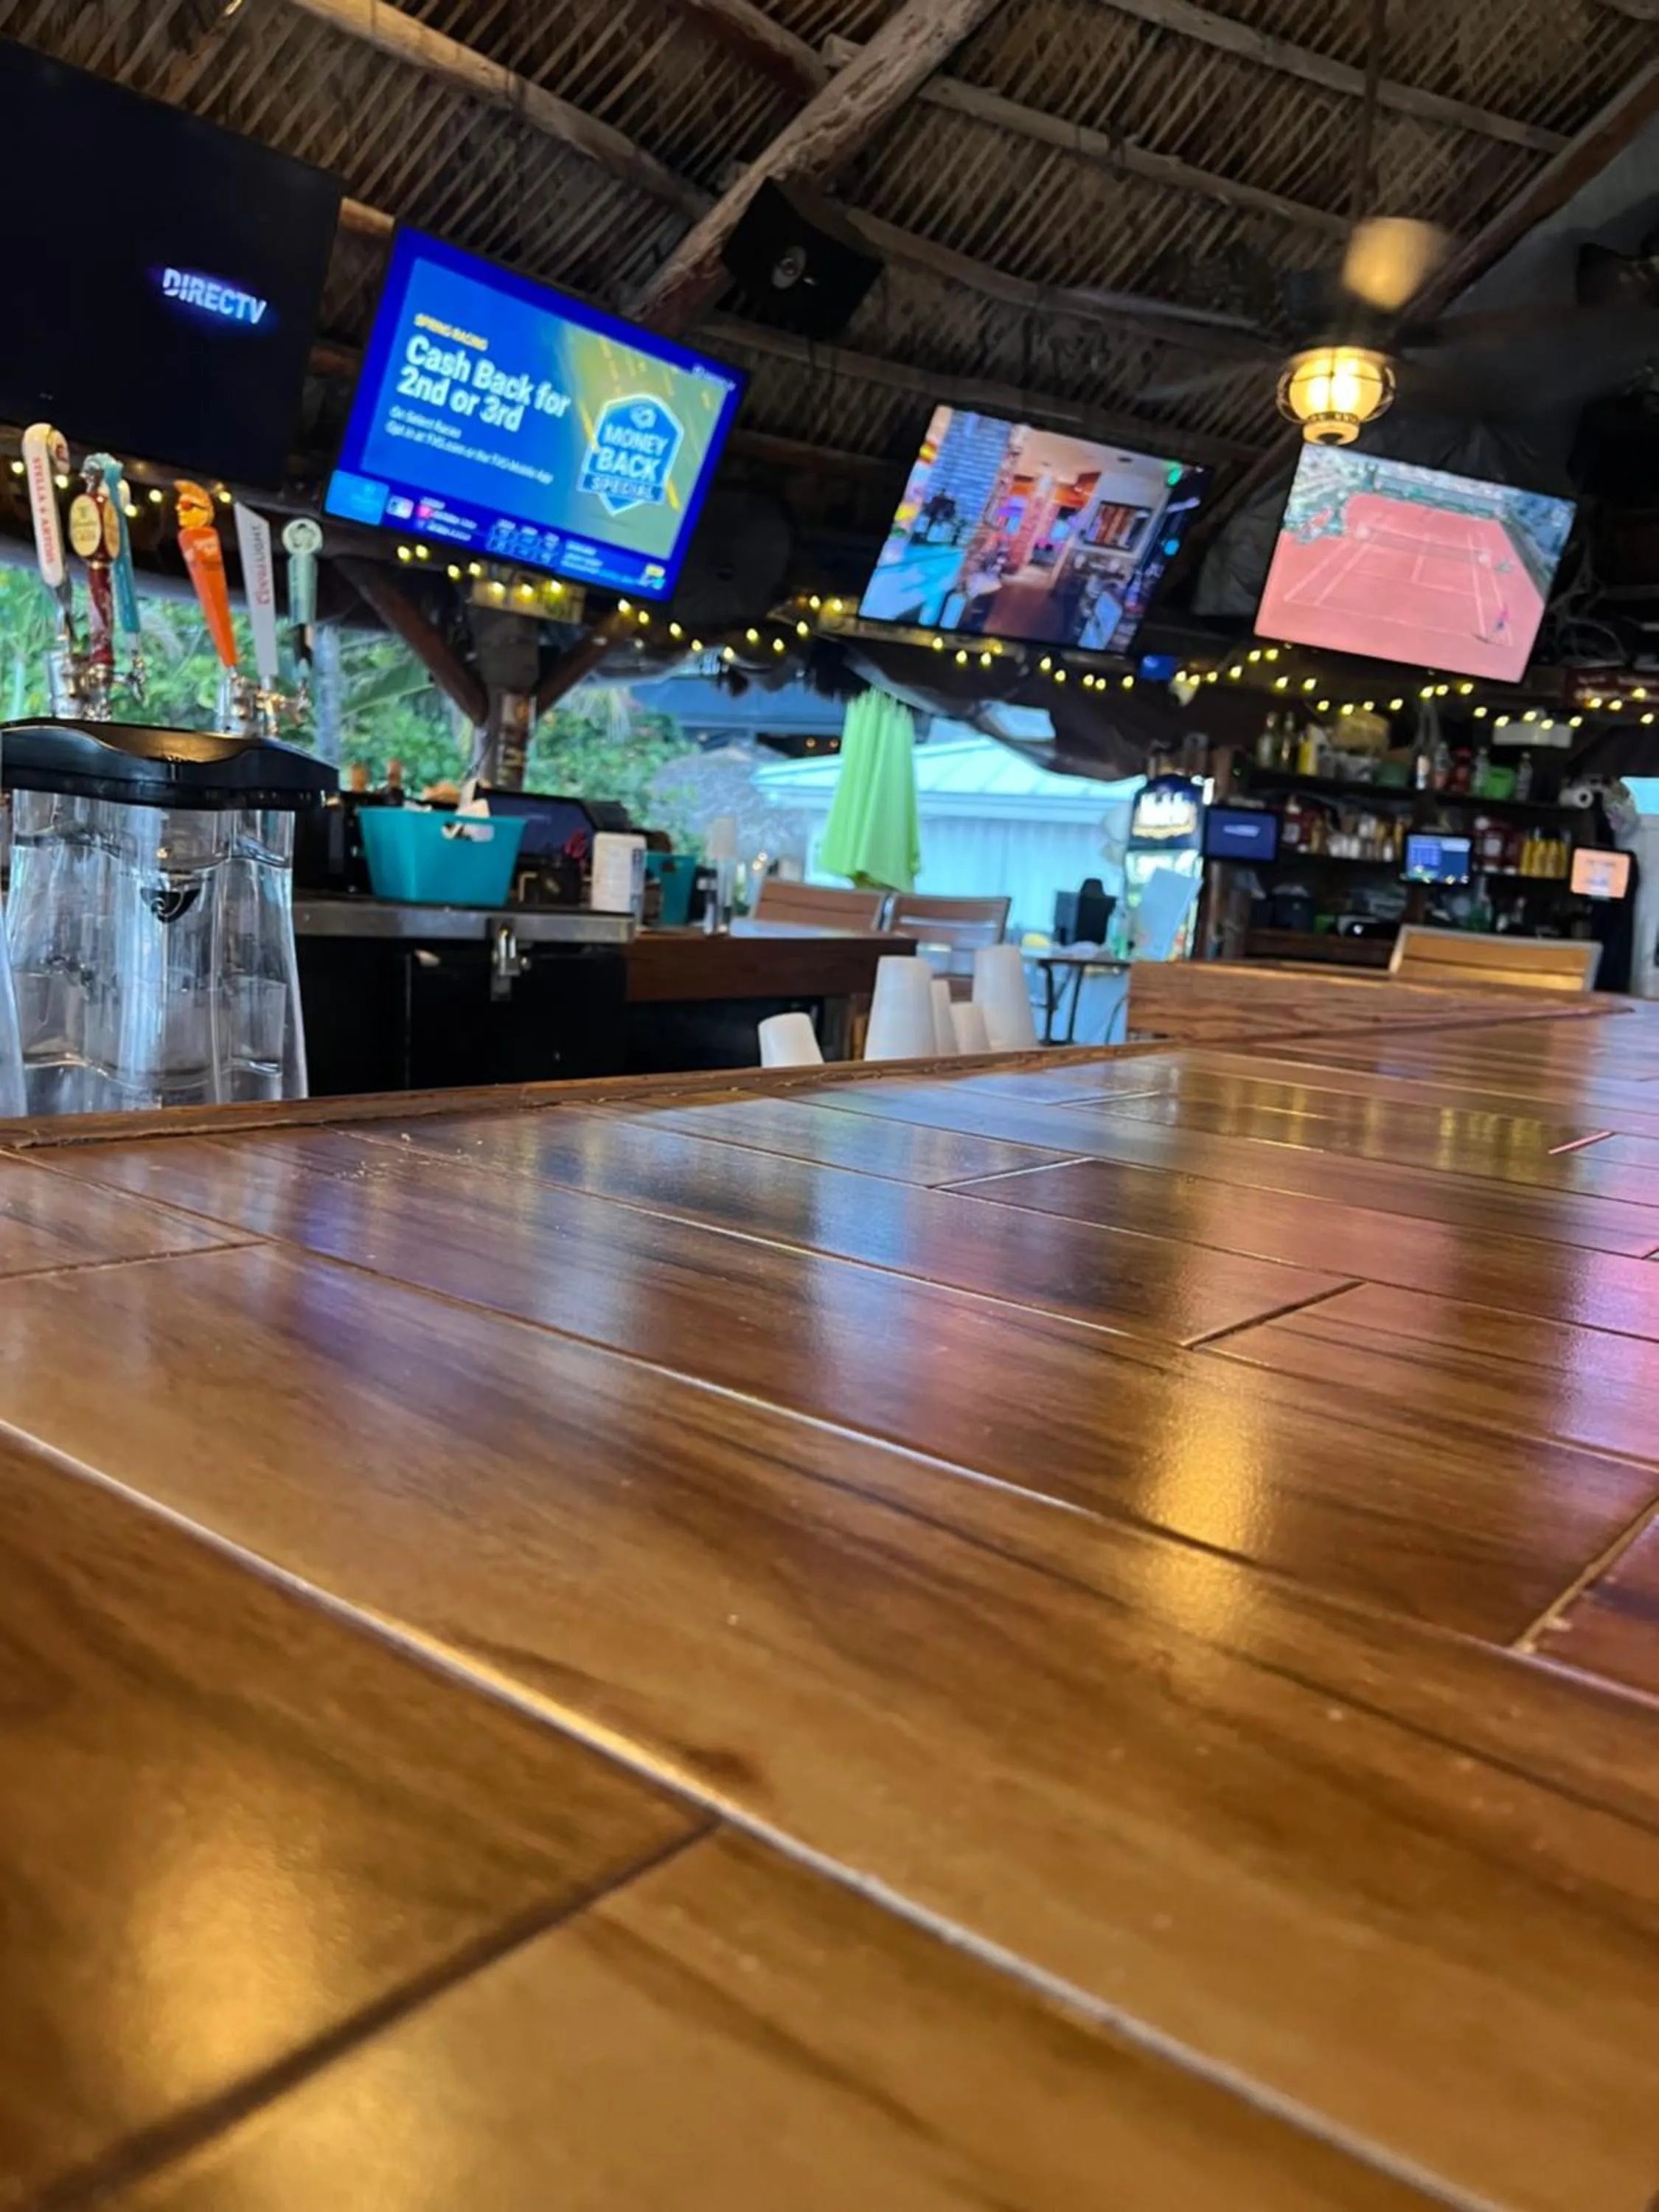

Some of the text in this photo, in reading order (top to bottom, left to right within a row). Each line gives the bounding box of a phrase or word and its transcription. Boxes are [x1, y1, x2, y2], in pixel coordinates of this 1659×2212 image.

[162, 267, 267, 324] DIRECTV
[397, 364, 525, 432] 2nd or 3rd
[406, 334, 571, 417] Cash Back for
[596, 446, 661, 482] BACK
[602, 423, 670, 457] MONEY
[32, 456, 55, 565] STELLA ARTOIS
[591, 476, 653, 500] SPECIAL
